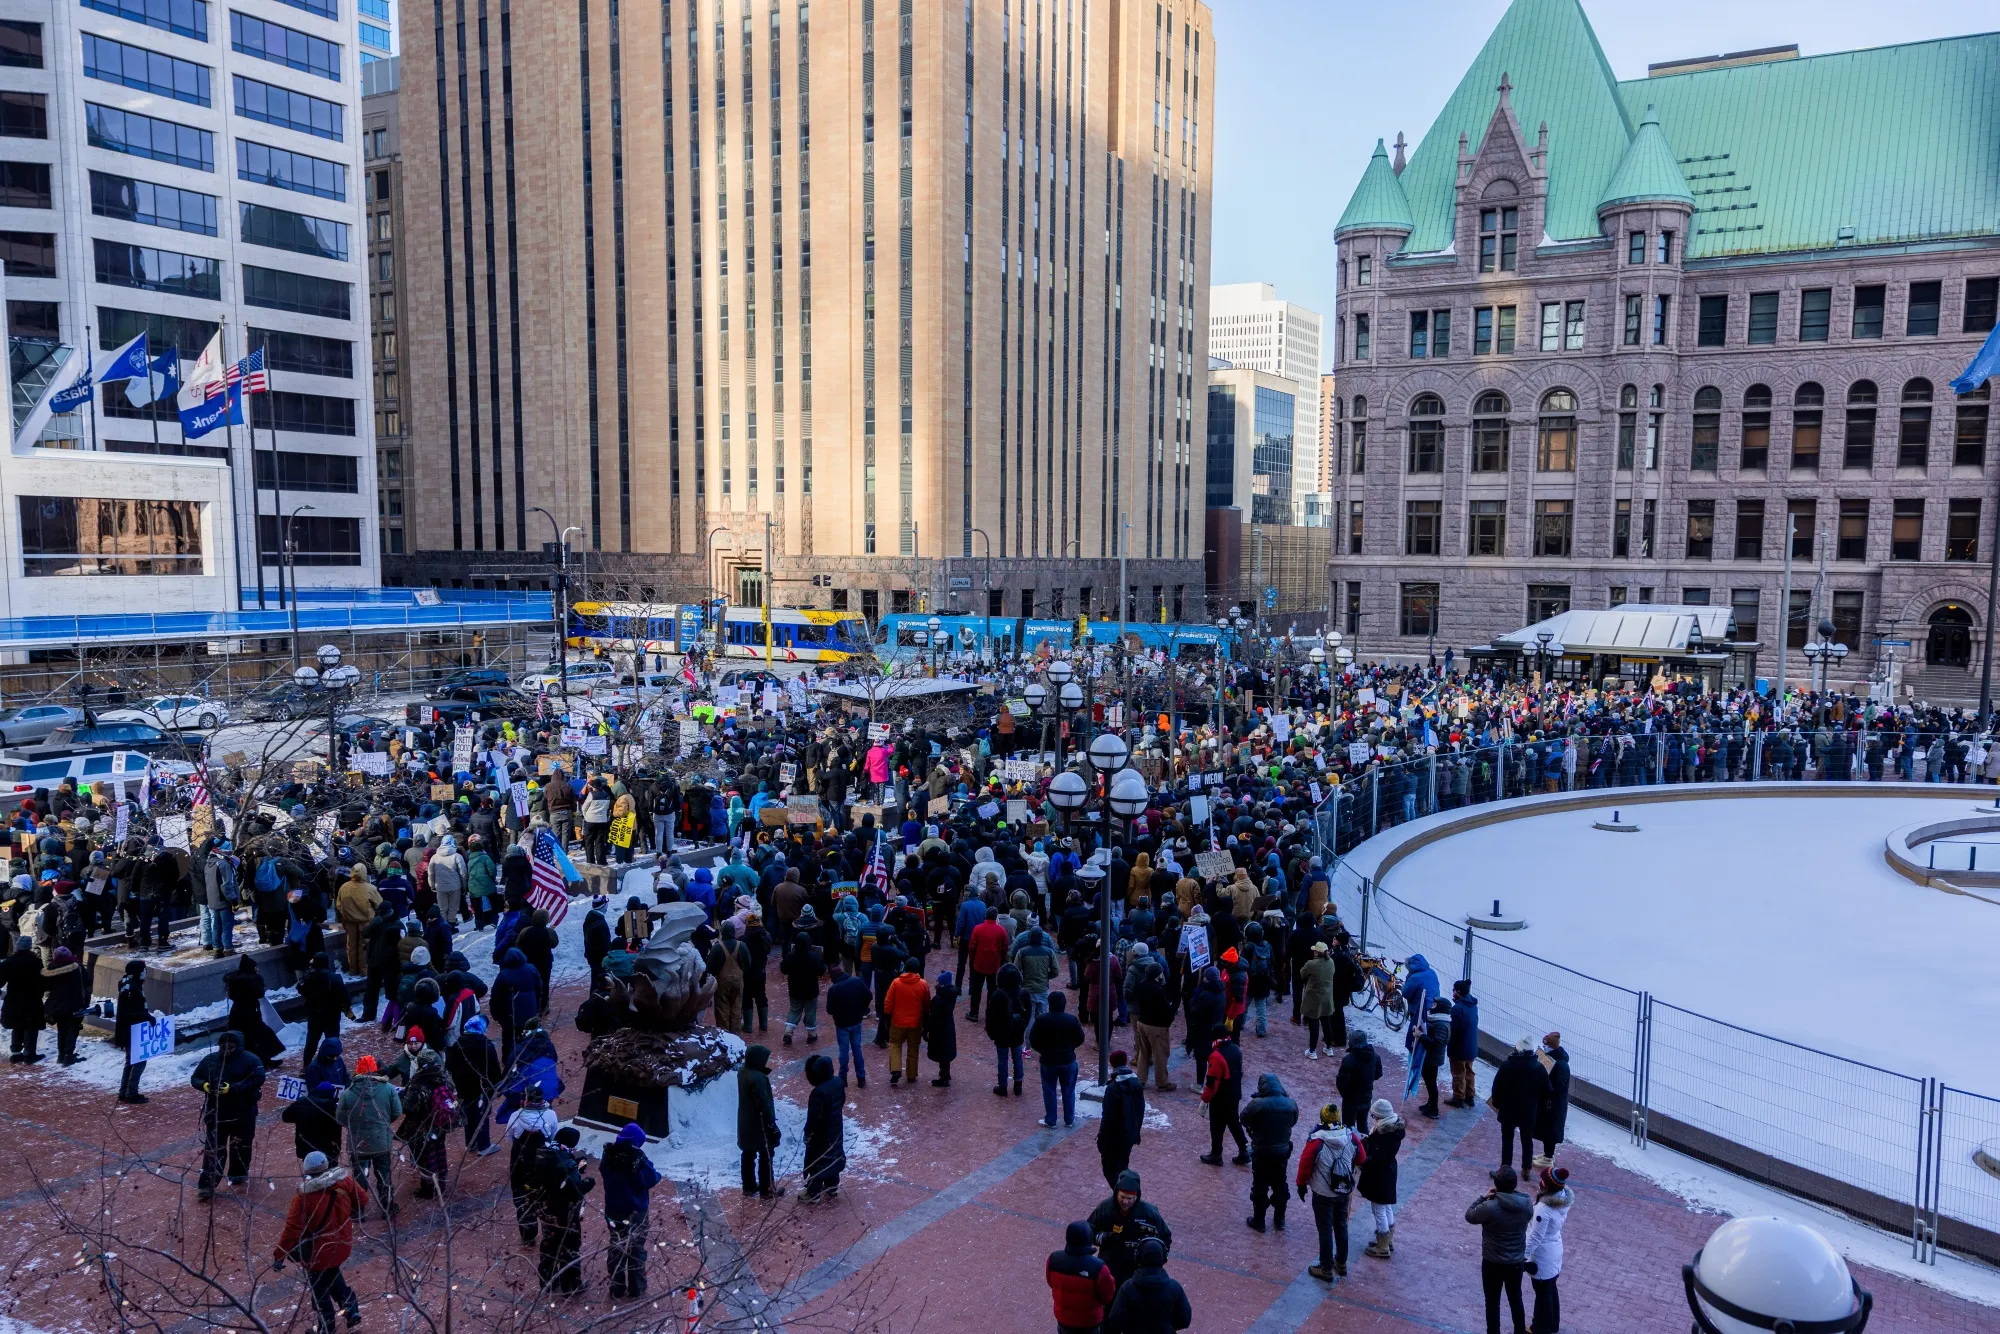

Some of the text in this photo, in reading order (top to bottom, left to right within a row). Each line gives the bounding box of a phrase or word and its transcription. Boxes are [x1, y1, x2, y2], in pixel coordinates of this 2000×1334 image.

[353, 761, 385, 772] FASCISM
[1143, 758, 1160, 768] ICE
[1197, 851, 1223, 861] MINN
[1214, 857, 1231, 866] GOOD
[1214, 865, 1231, 873] EVIL
[140, 1017, 172, 1042] FUCK
